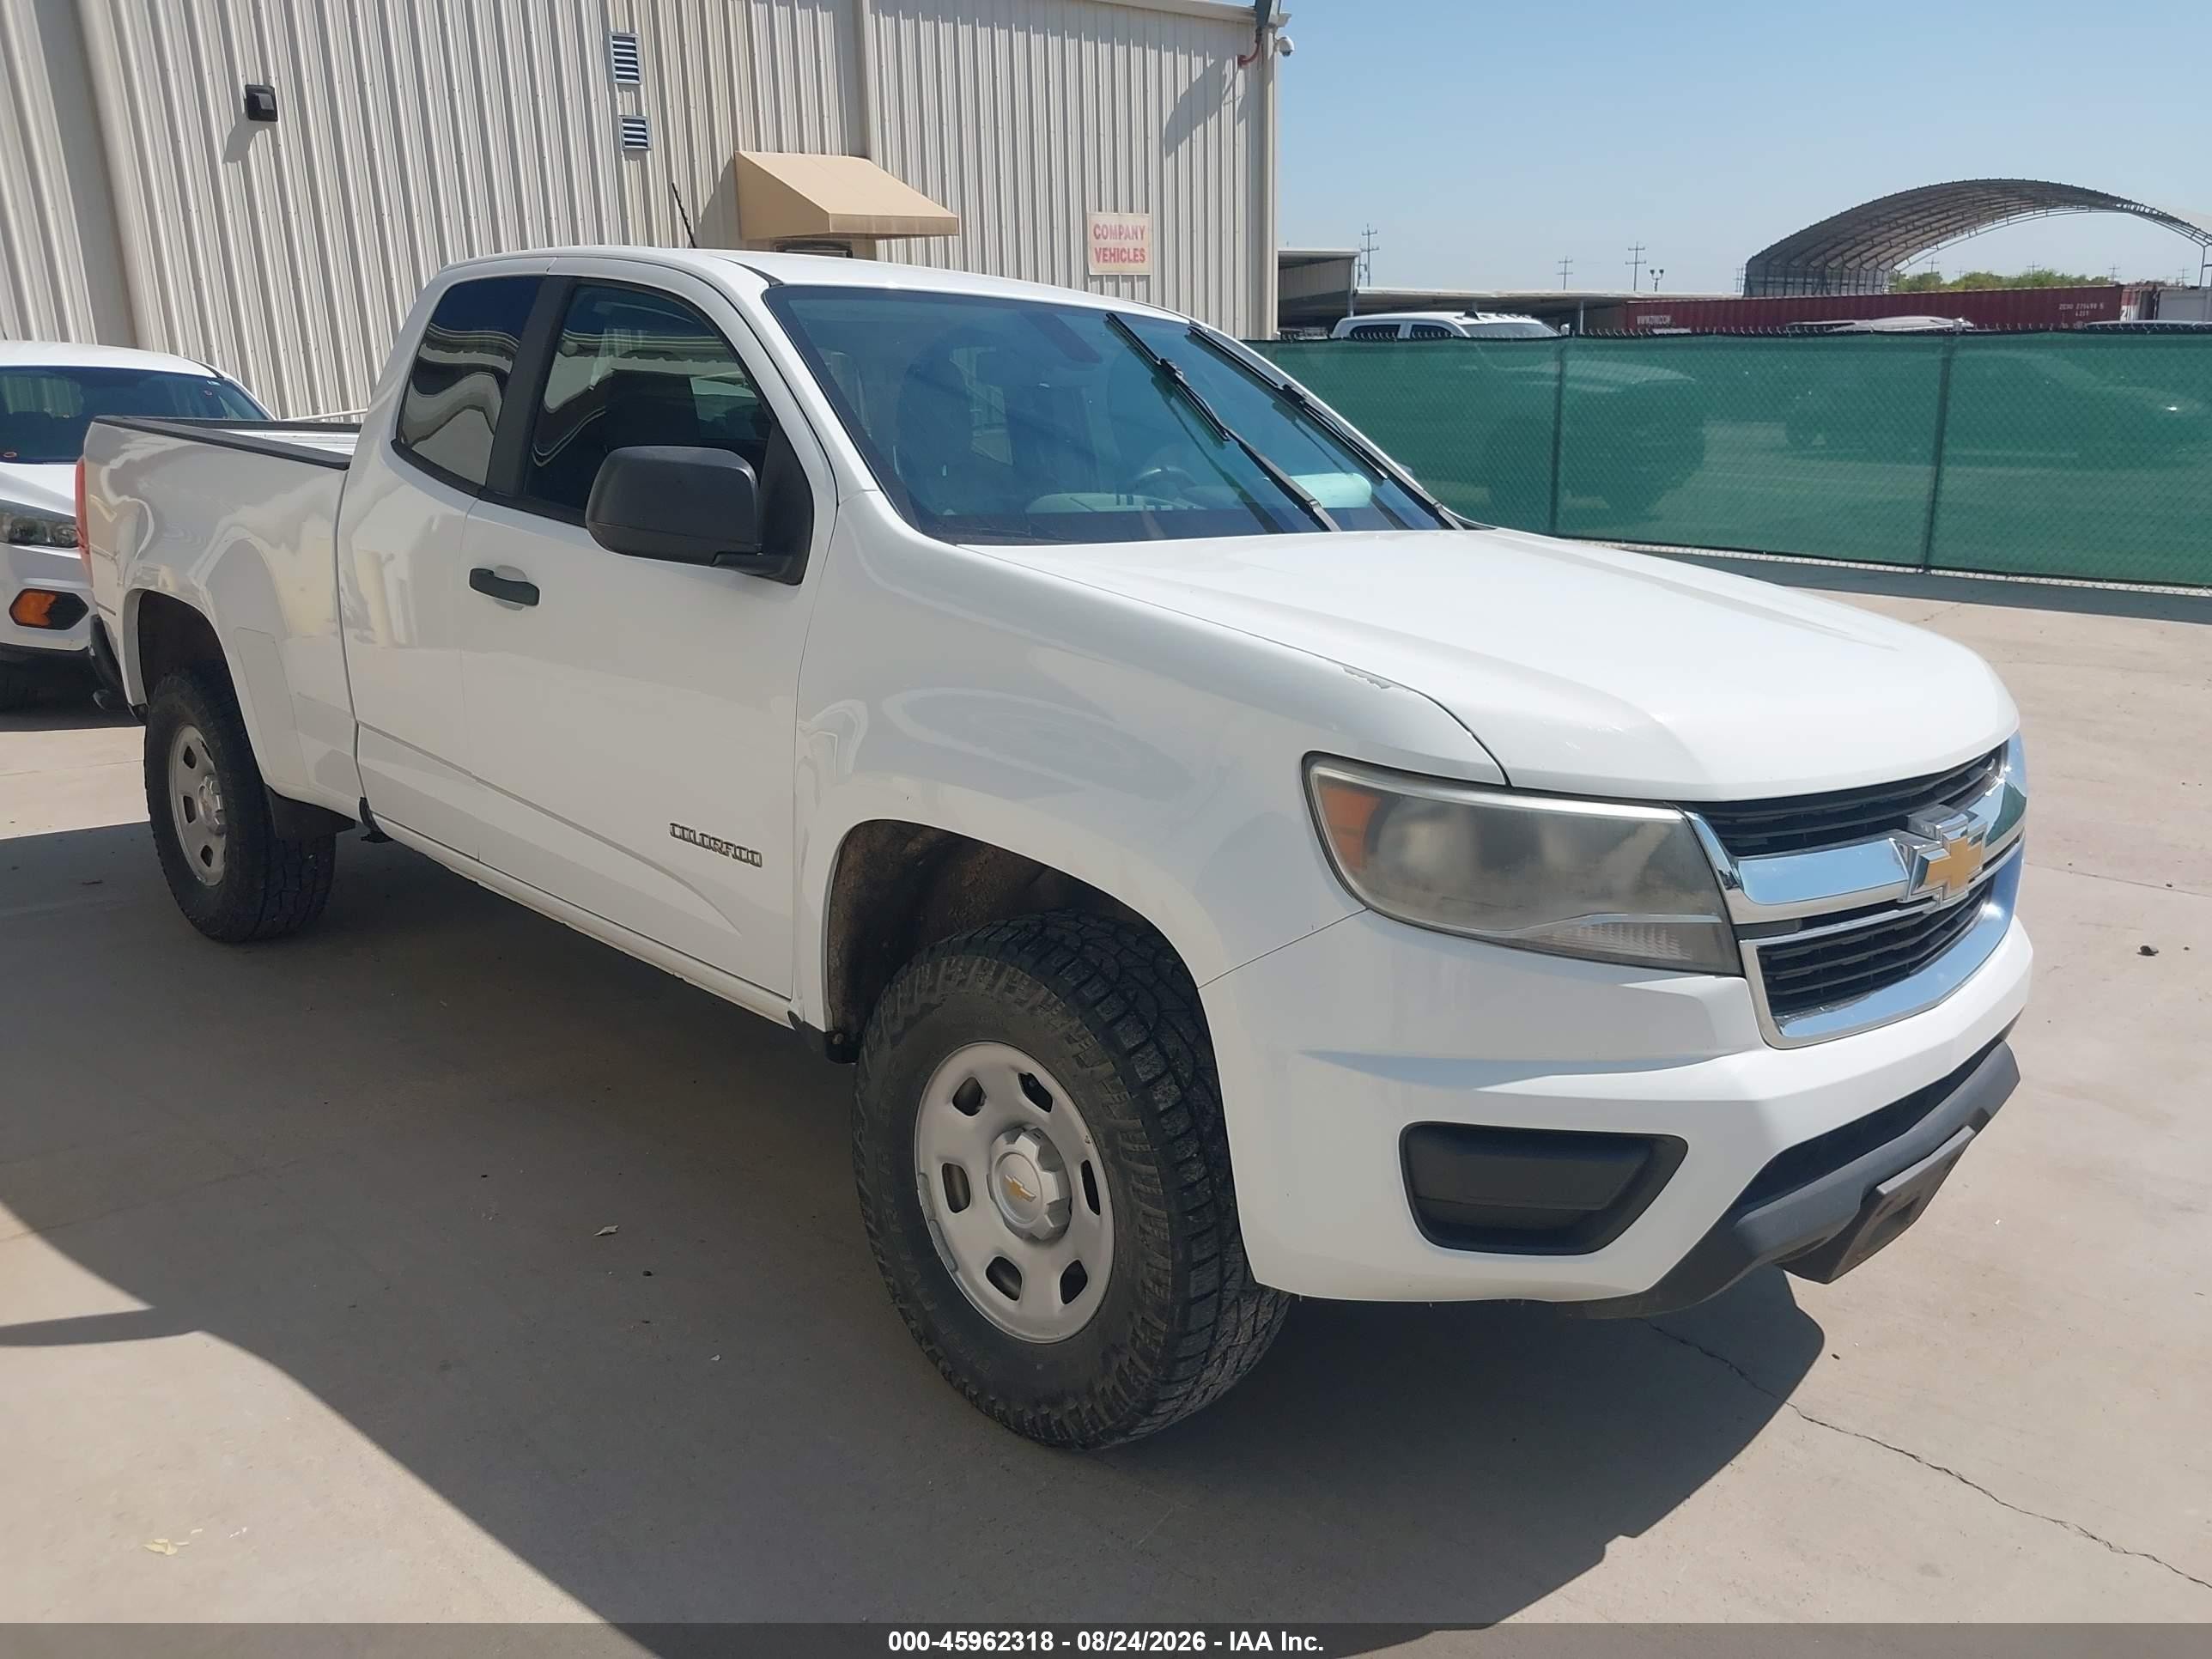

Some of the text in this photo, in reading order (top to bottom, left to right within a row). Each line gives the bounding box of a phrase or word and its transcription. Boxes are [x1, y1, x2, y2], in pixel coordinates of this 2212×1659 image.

[1093, 224, 1146, 240] COMPANY
[1095, 247, 1146, 264] VEHICLES
[670, 823, 763, 868] COLORADO
